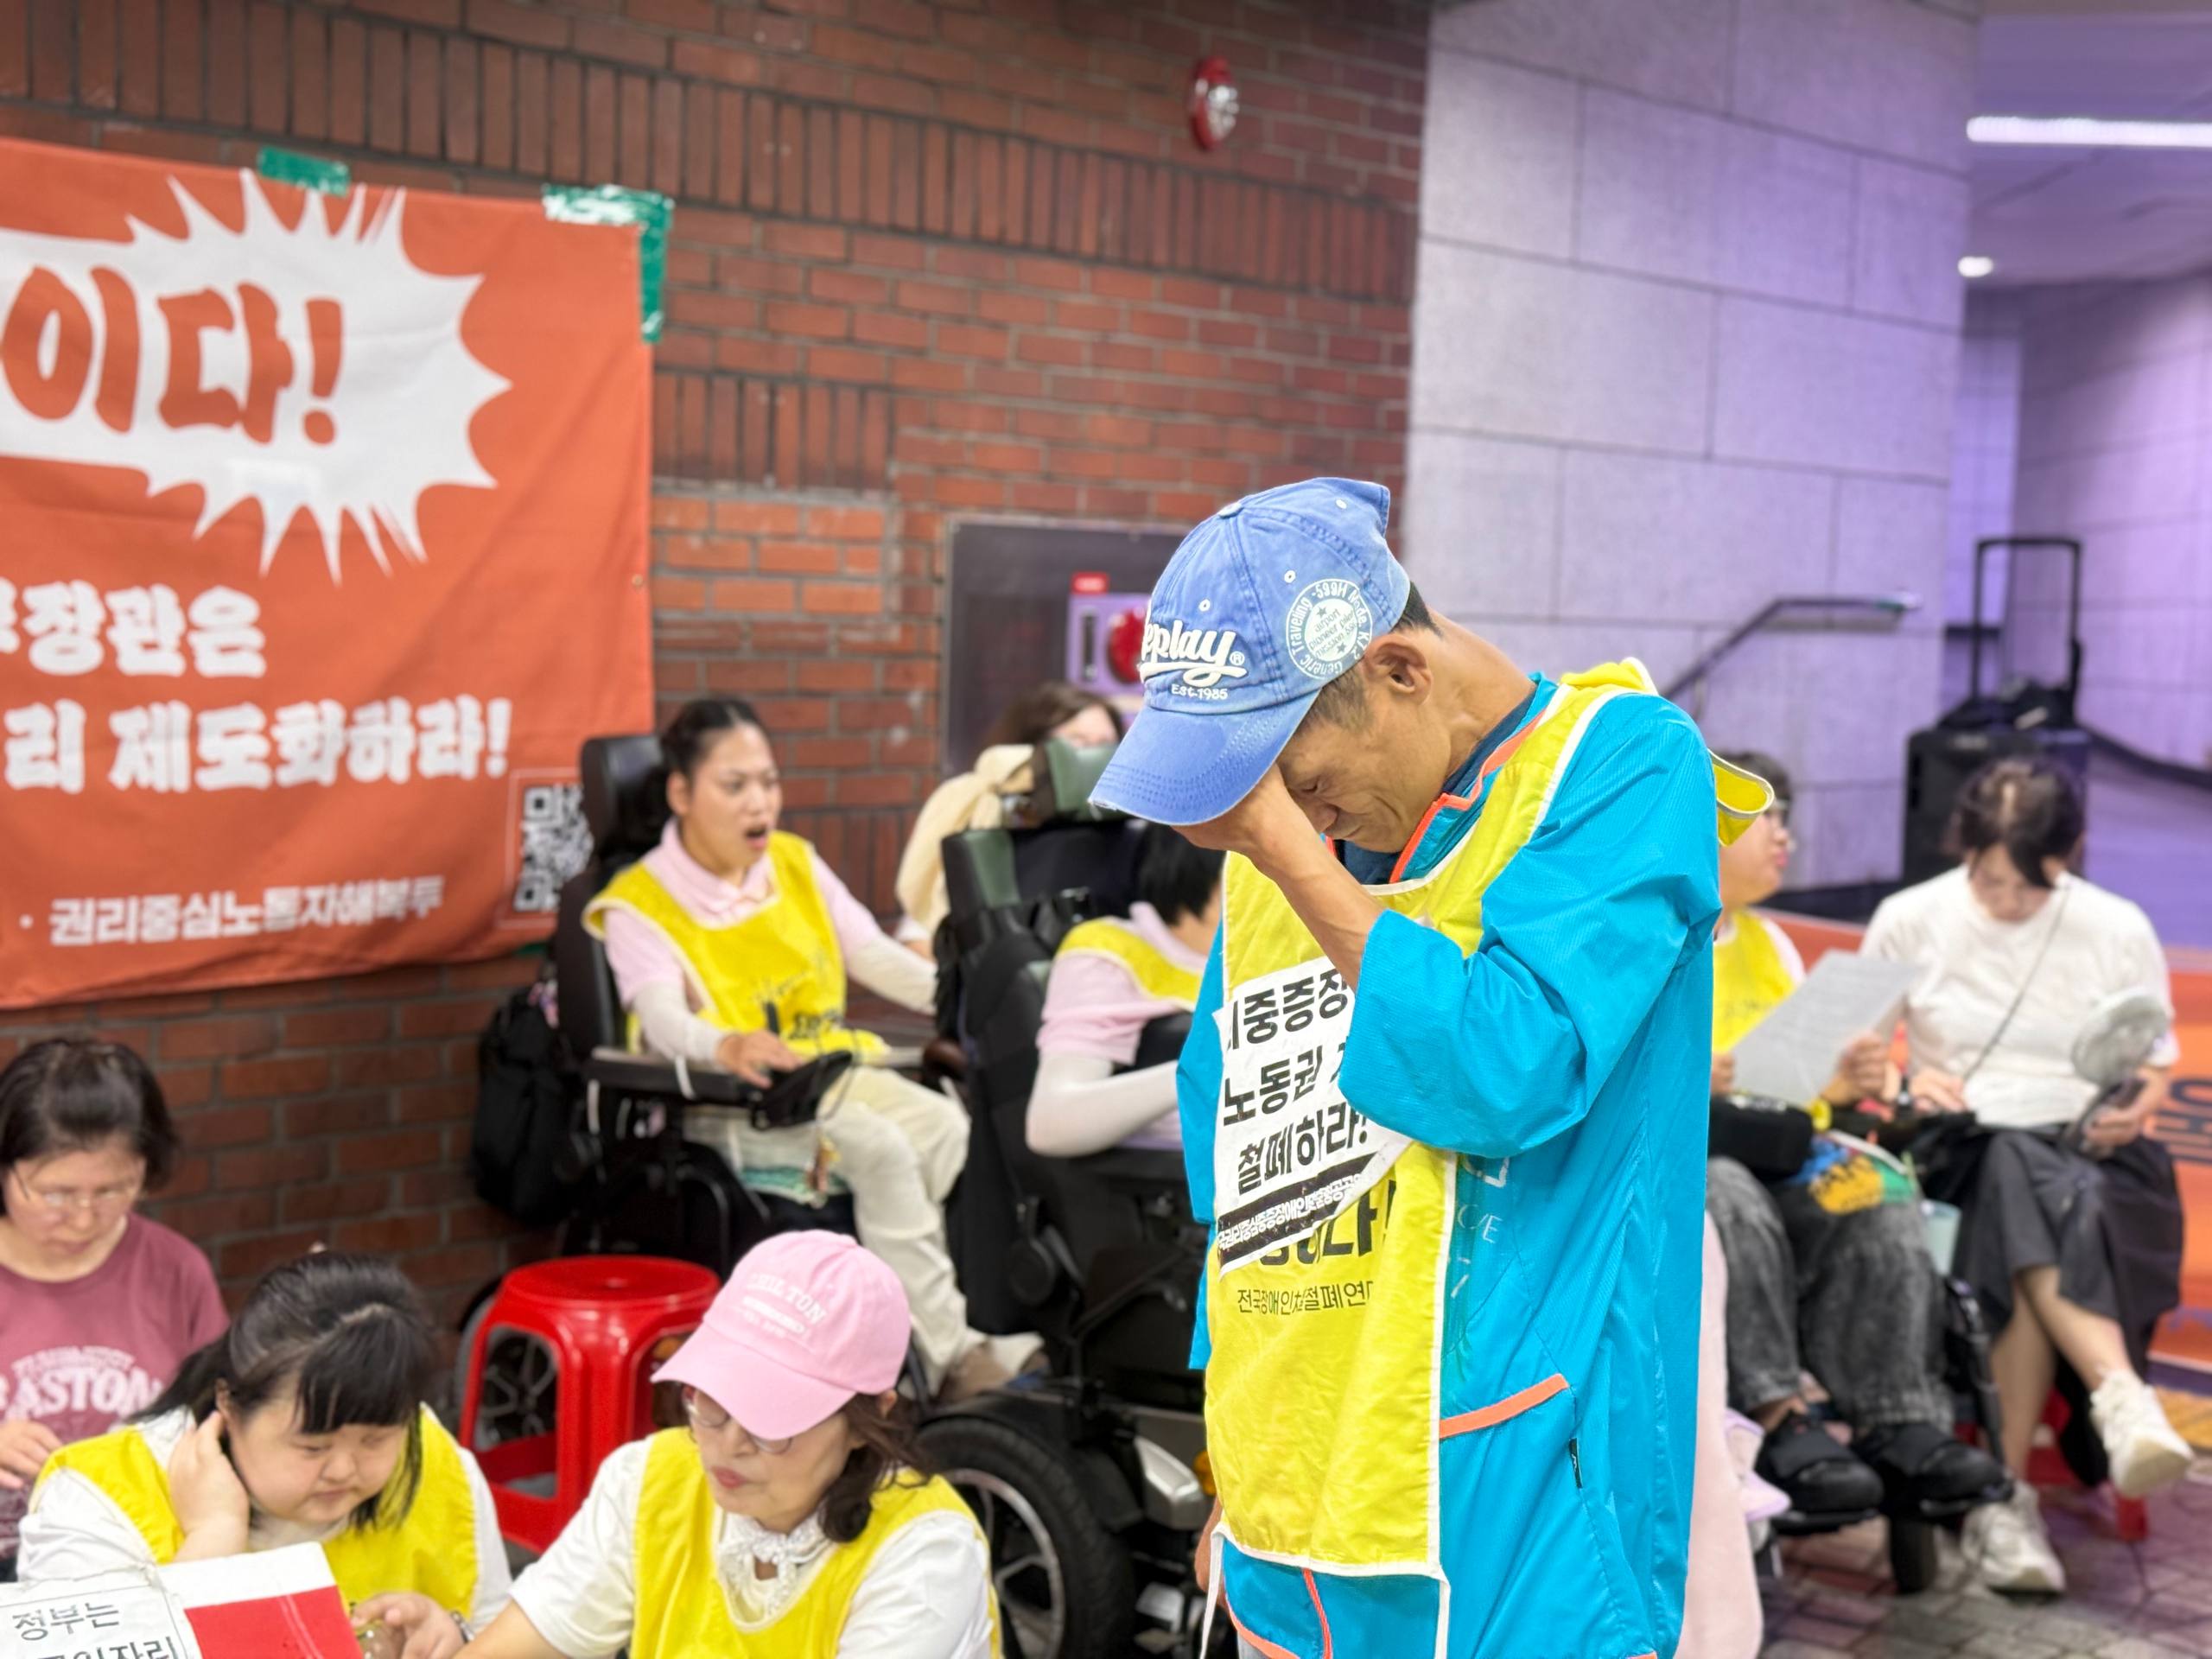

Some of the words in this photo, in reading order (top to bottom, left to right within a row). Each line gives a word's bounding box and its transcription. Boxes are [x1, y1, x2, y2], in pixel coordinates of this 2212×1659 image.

[2, 264, 344, 446] 이다!
[109, 695, 512, 793] 제도화하라!
[1224, 1045, 1324, 1127] 노동권
[12, 1602, 120, 1642] 정부는
